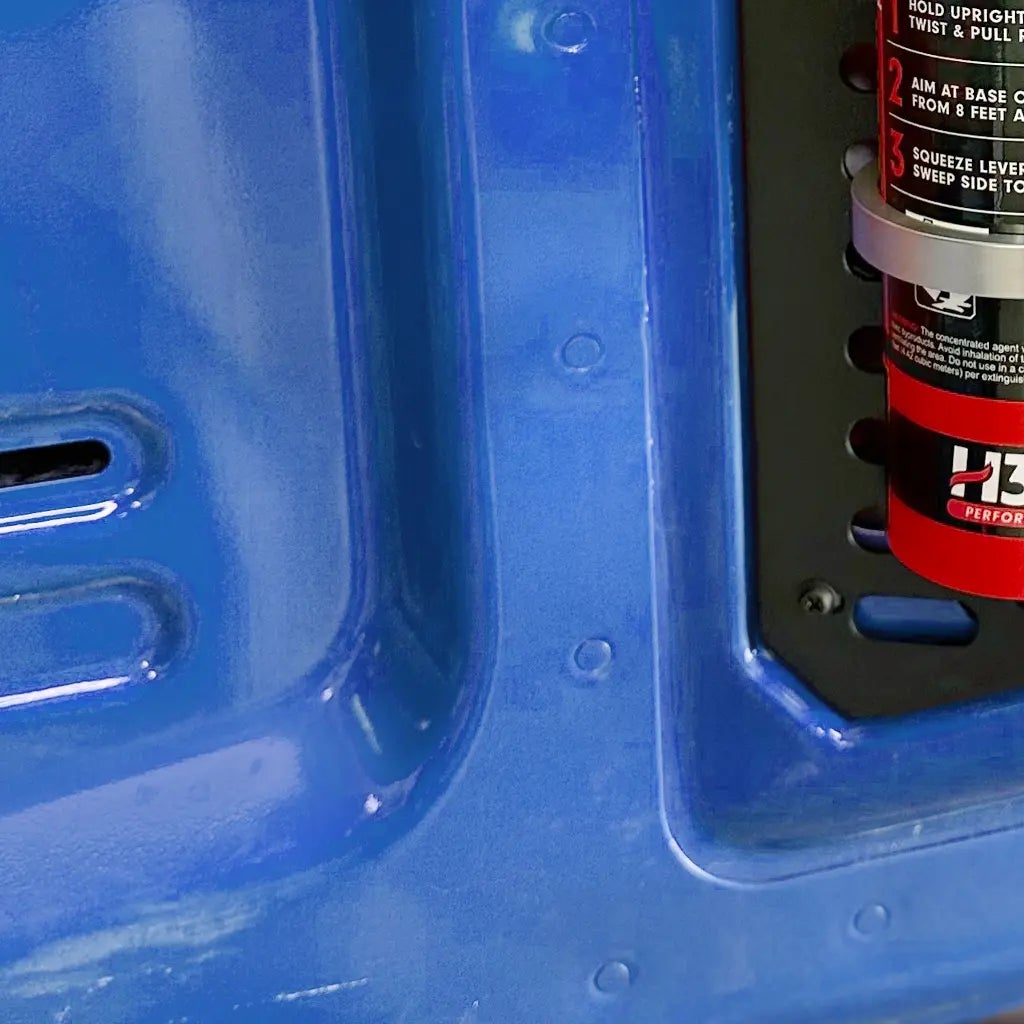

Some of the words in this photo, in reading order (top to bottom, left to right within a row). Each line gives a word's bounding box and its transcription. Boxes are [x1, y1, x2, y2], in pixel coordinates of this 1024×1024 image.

[908, 14, 948, 36] TWIST
[953, 24, 964, 38] &
[970, 26, 1012, 42] PULL
[889, 57, 903, 107] 2
[911, 76, 936, 95] AIM
[941, 83, 959, 99] AT
[965, 86, 1007, 104] BASE
[912, 93, 950, 115] FROM
[955, 103, 965, 117] 8
[970, 105, 1007, 122] FEET
[890, 128, 905, 177] 3
[912, 146, 973, 172] SQUEEZE
[913, 163, 956, 186] SWEEP
[961, 175, 998, 192] SIDE
[920, 325, 934, 338] The
[935, 333, 989, 351] concentrated
[992, 343, 1019, 354] agent
[938, 342, 961, 356] Avoid
[962, 348, 1007, 362] inhalation
[1008, 353, 1018, 363] of
[933, 362, 963, 378] meters)
[964, 370, 980, 380] per
[948, 355, 961, 366] Do
[962, 360, 976, 370] not
[978, 362, 996, 372] use
[998, 363, 1007, 373] in
